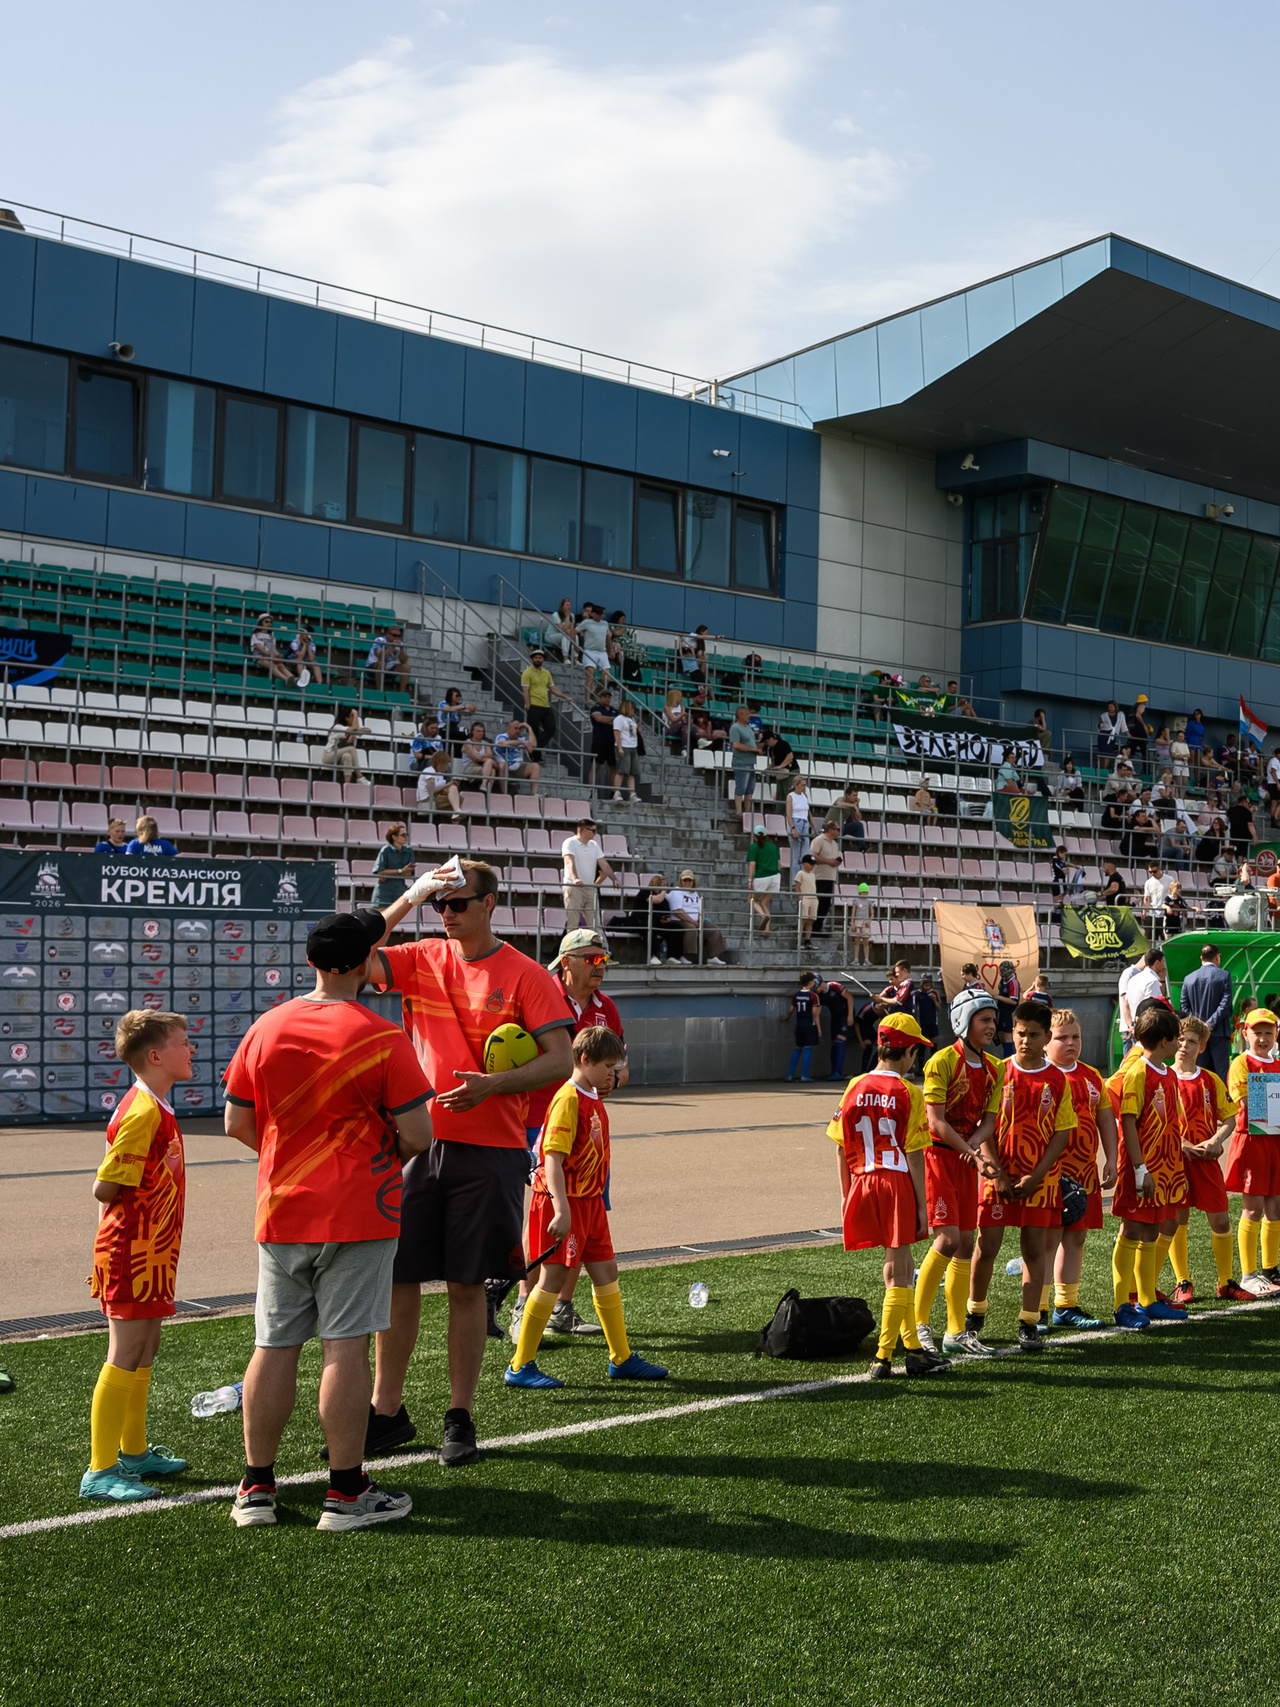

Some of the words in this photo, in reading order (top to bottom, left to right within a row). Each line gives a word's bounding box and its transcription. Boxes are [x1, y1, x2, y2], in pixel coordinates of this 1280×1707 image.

[0, 637, 38, 662] ИЛИ
[101, 865, 149, 877] КУБОК
[152, 868, 241, 881] КАЗАНСКОГО
[101, 878, 242, 906] КРЕМЛЯ
[35, 900, 61, 908] 2026
[277, 906, 300, 914] 2026
[797, 1001, 806, 1012] 11
[856, 1093, 896, 1110] СЛАВА
[855, 1115, 909, 1173] 13
